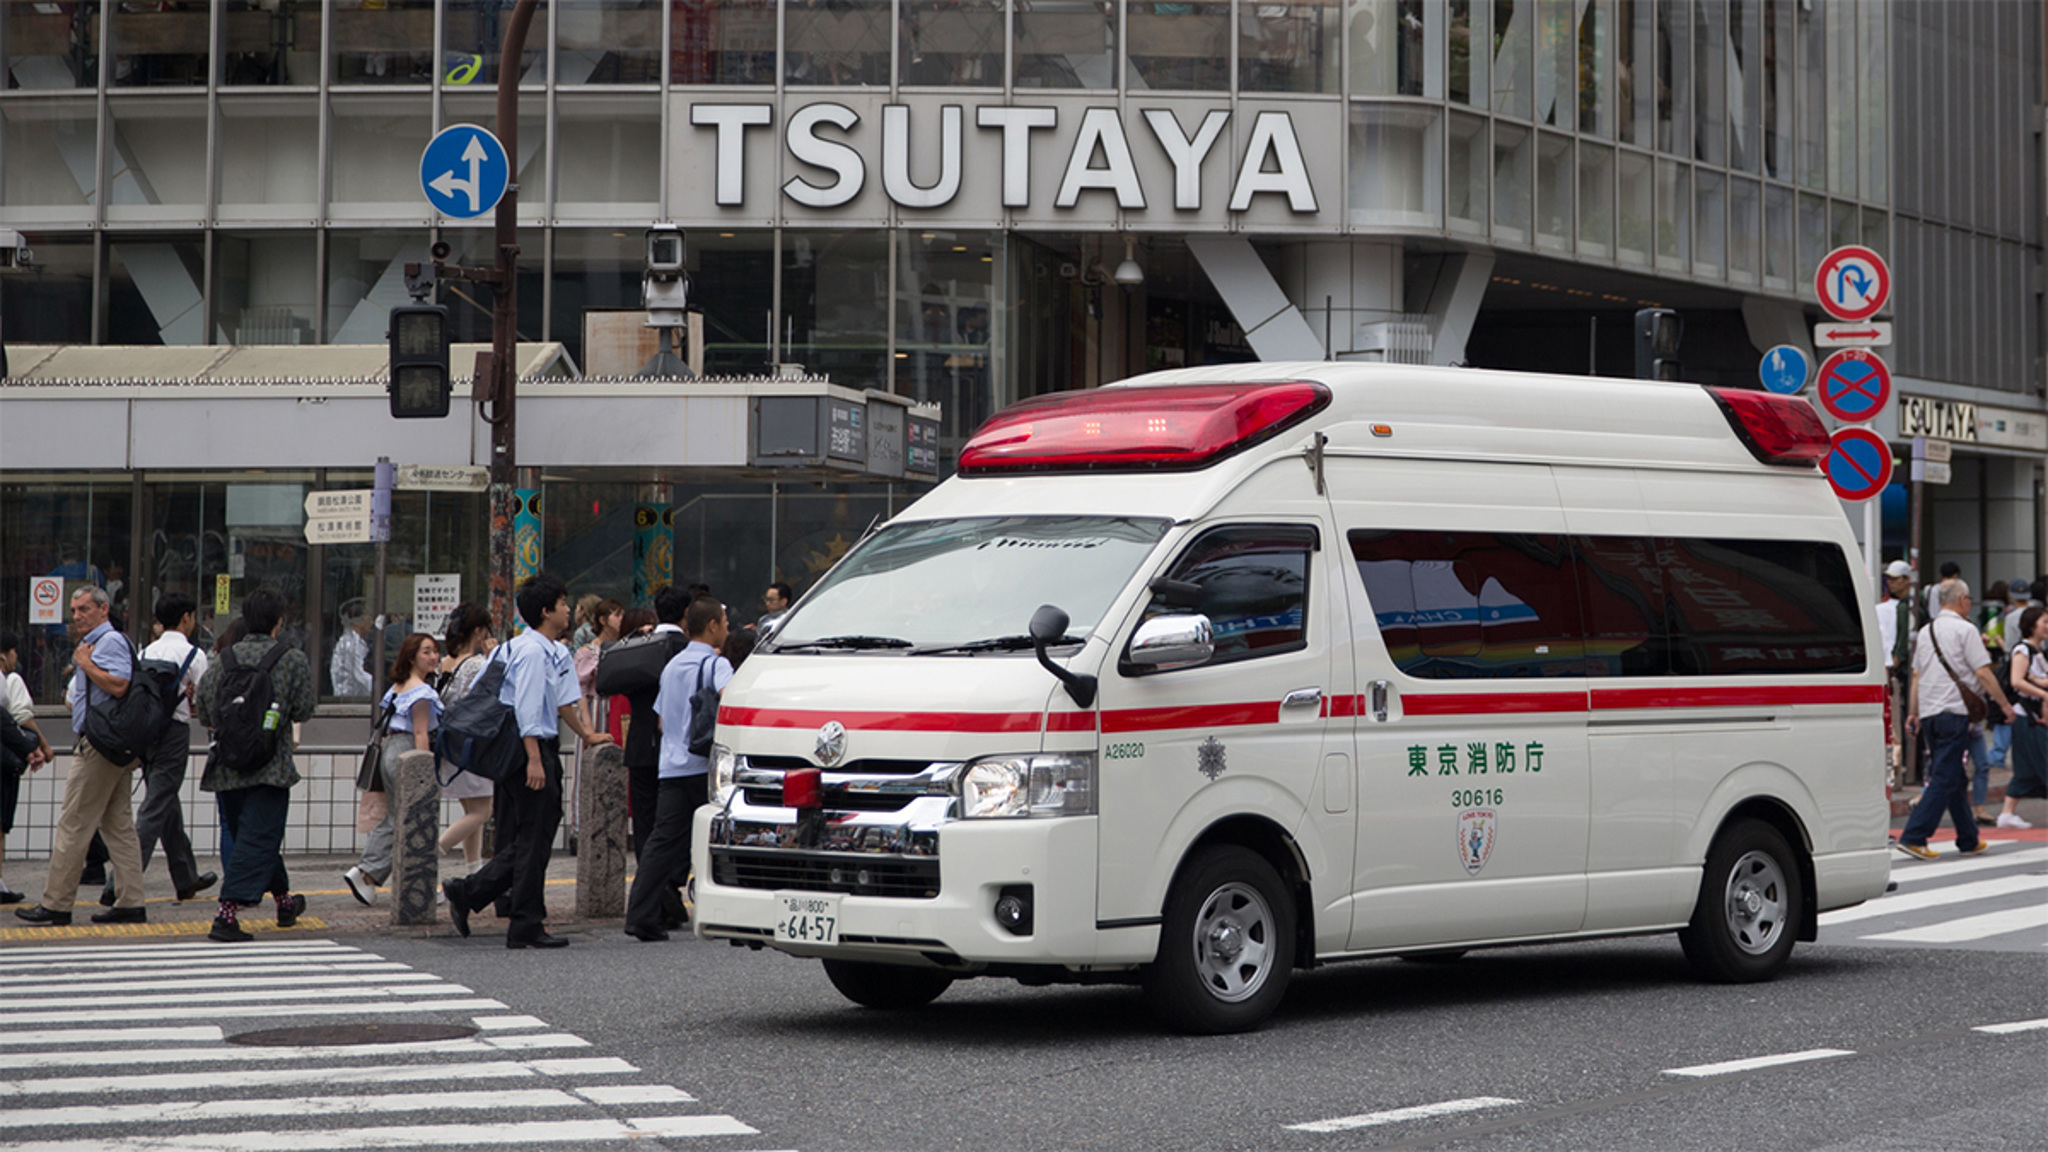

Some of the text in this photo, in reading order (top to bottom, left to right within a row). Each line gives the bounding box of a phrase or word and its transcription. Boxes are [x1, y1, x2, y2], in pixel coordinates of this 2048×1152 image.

[690, 102, 1320, 213] TSUTAYA
[1900, 398, 1977, 440] TSUTAYA
[637, 511, 647, 525] 6
[1104, 742, 1145, 759] A26020
[1407, 740, 1544, 776] 東京消防庁
[1452, 788, 1503, 807] 30616
[788, 915, 835, 941] 64-57
